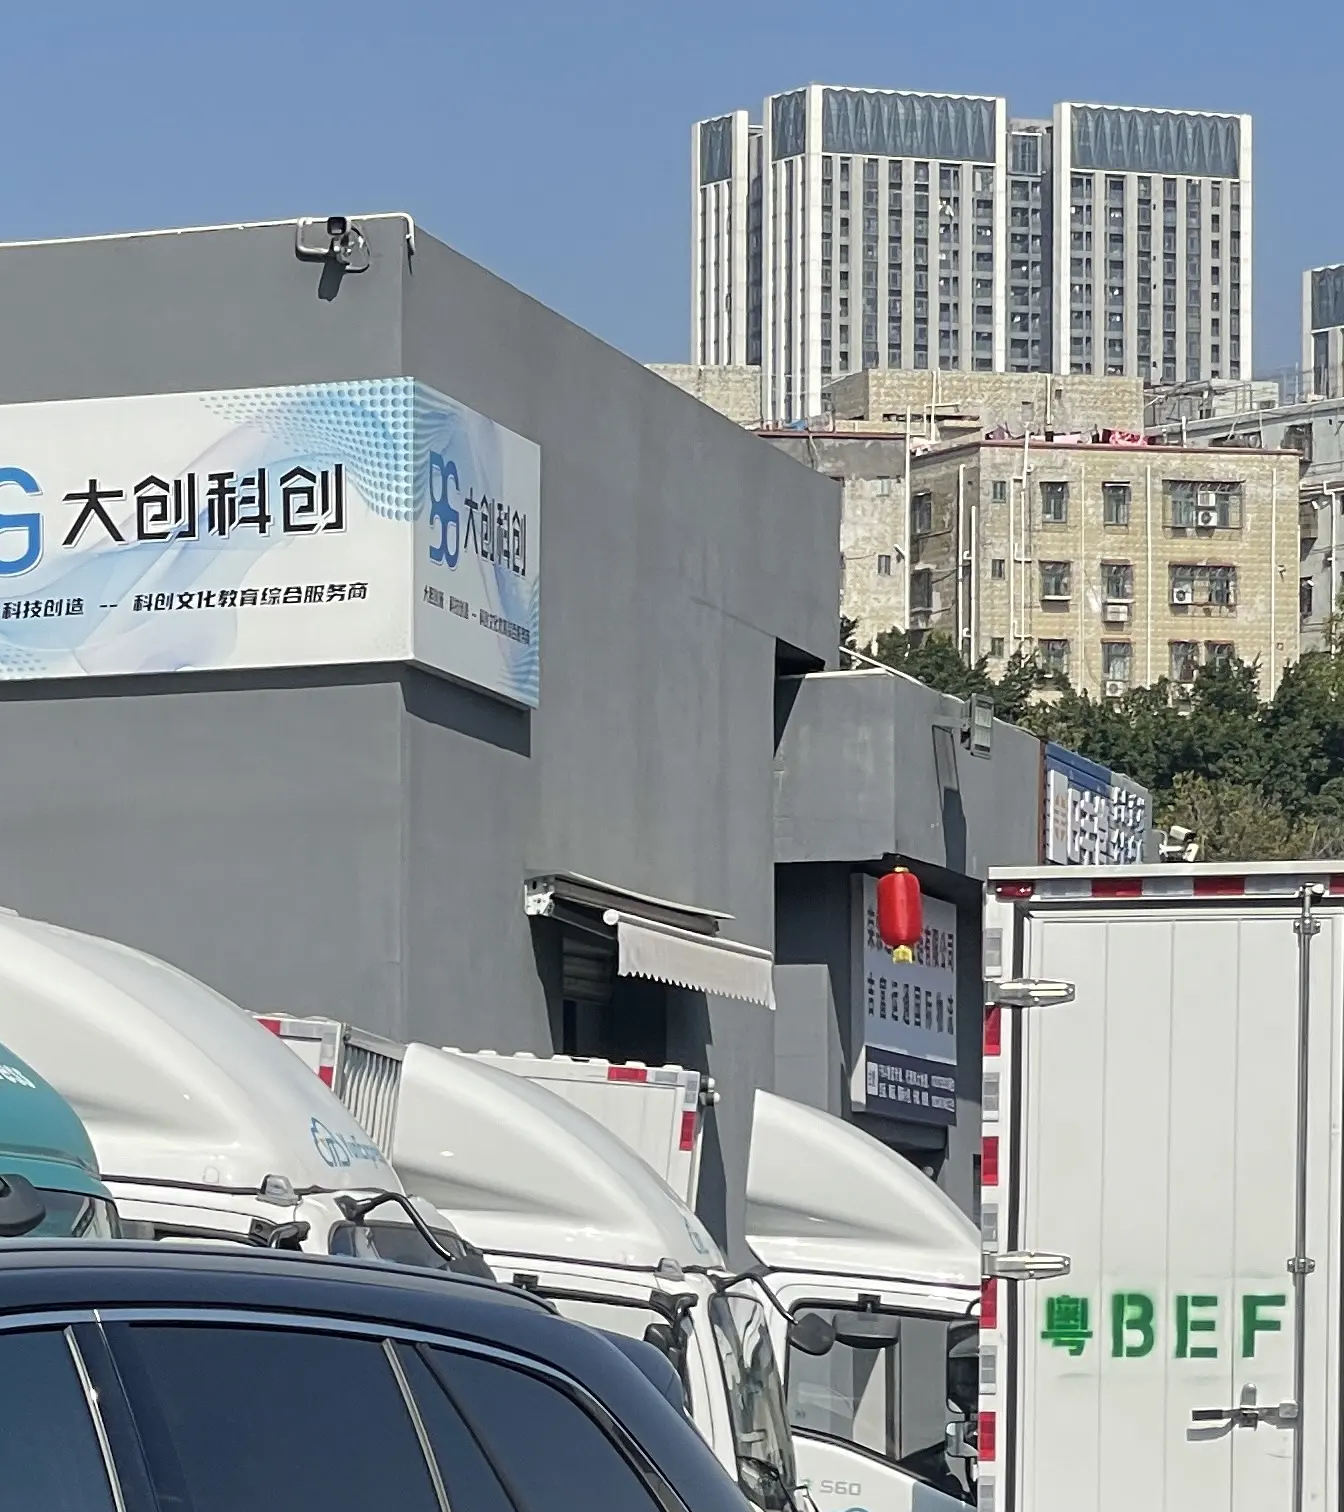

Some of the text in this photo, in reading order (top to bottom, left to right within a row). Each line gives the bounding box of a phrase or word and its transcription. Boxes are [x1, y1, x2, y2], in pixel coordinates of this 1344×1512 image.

[62, 463, 346, 549] 大创科创
[133, 581, 368, 613] 科创文化教育综合服务商
[820, 1479, 862, 1497] S60
